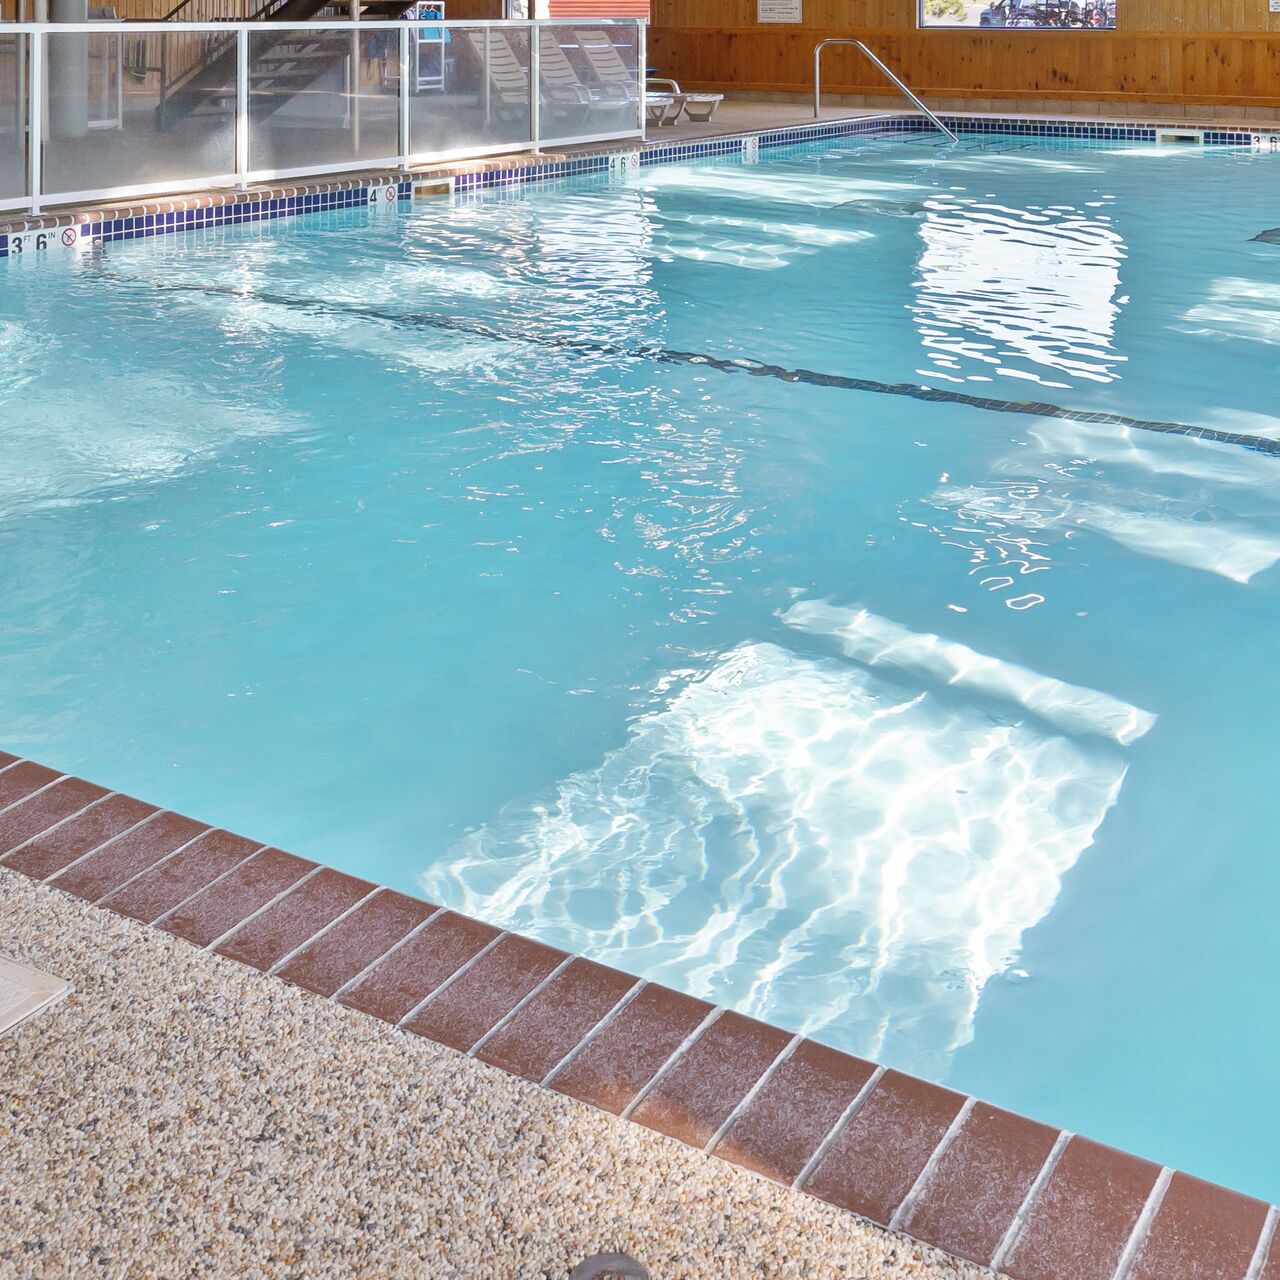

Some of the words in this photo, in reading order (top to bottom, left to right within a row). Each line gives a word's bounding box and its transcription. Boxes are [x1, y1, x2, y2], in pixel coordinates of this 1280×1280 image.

[370, 189, 377, 202] 4
[11, 236, 23, 254] 3
[23, 235, 31, 243] FT
[36, 233, 47, 251] 6
[48, 231, 56, 239] IN
